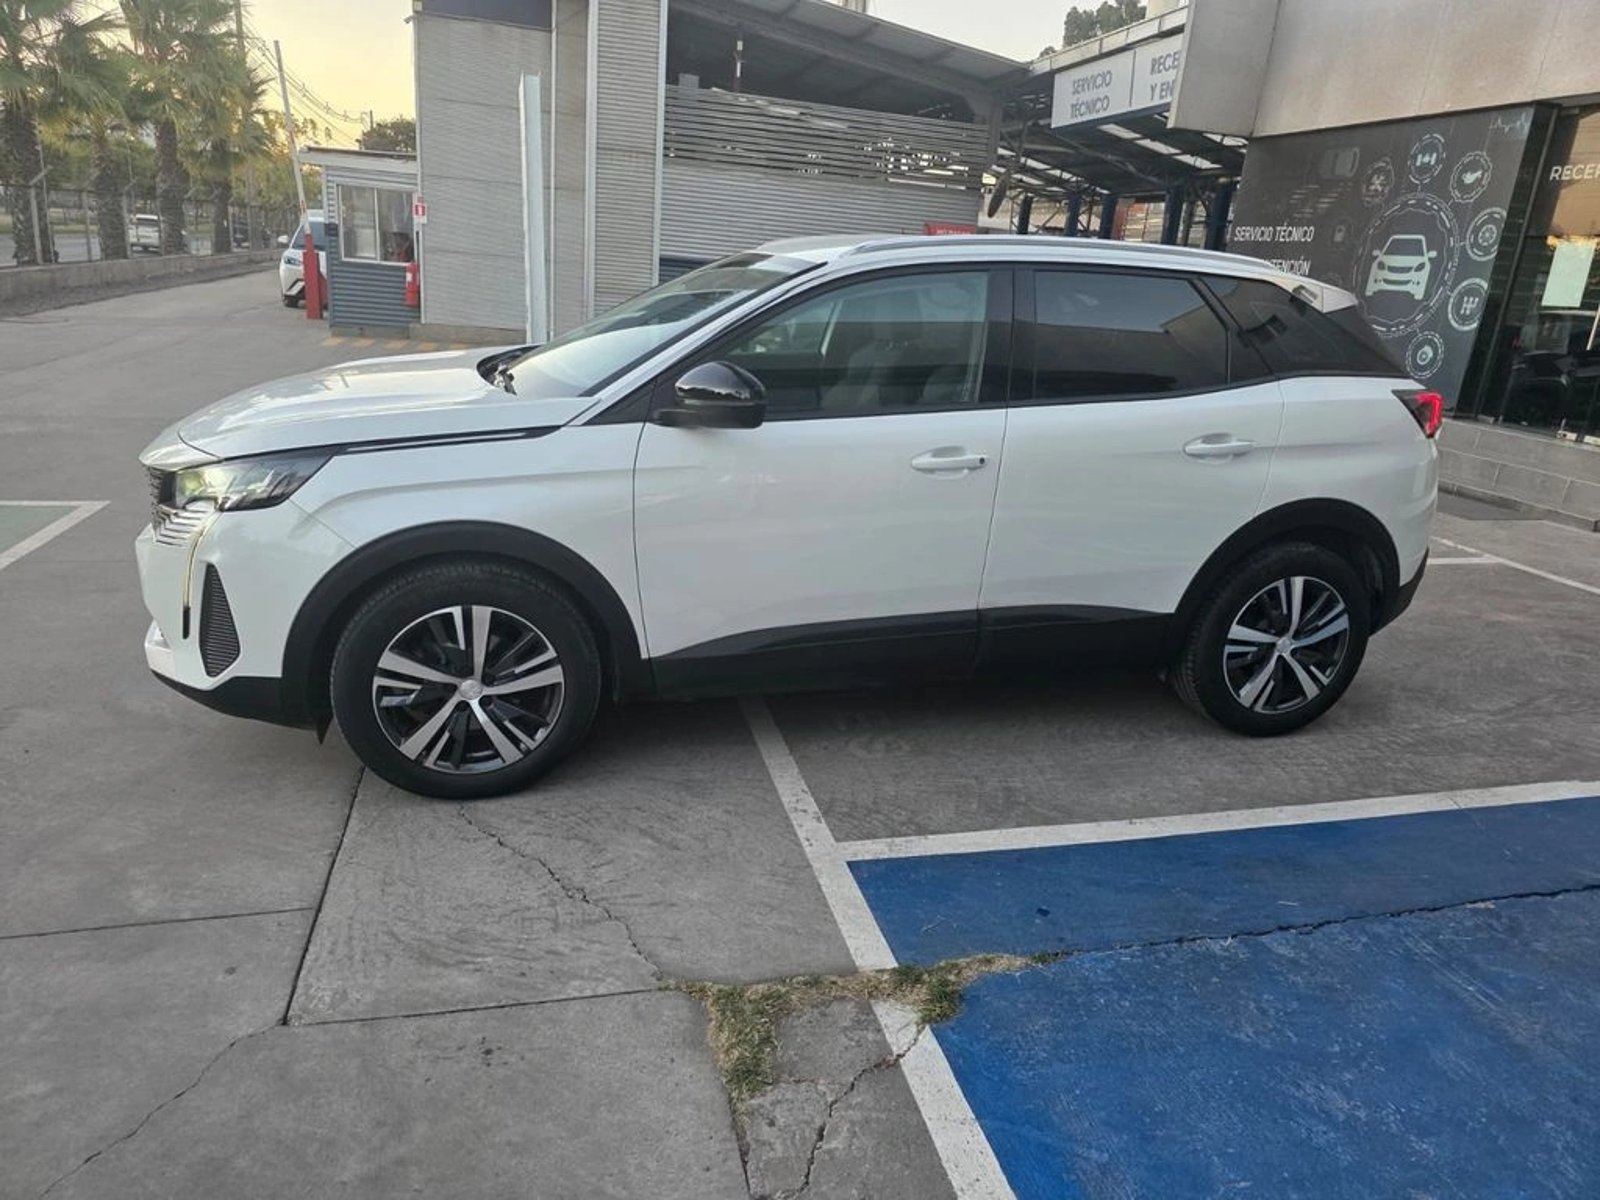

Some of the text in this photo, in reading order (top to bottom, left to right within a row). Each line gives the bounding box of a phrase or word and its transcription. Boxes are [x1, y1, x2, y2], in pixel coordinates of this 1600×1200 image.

[1072, 70, 1113, 96] SERVICIO
[1150, 83, 1157, 101] Y
[1071, 94, 1110, 119] TÉCNICO
[1234, 221, 1315, 242] SERVICIO TÉCNICO
